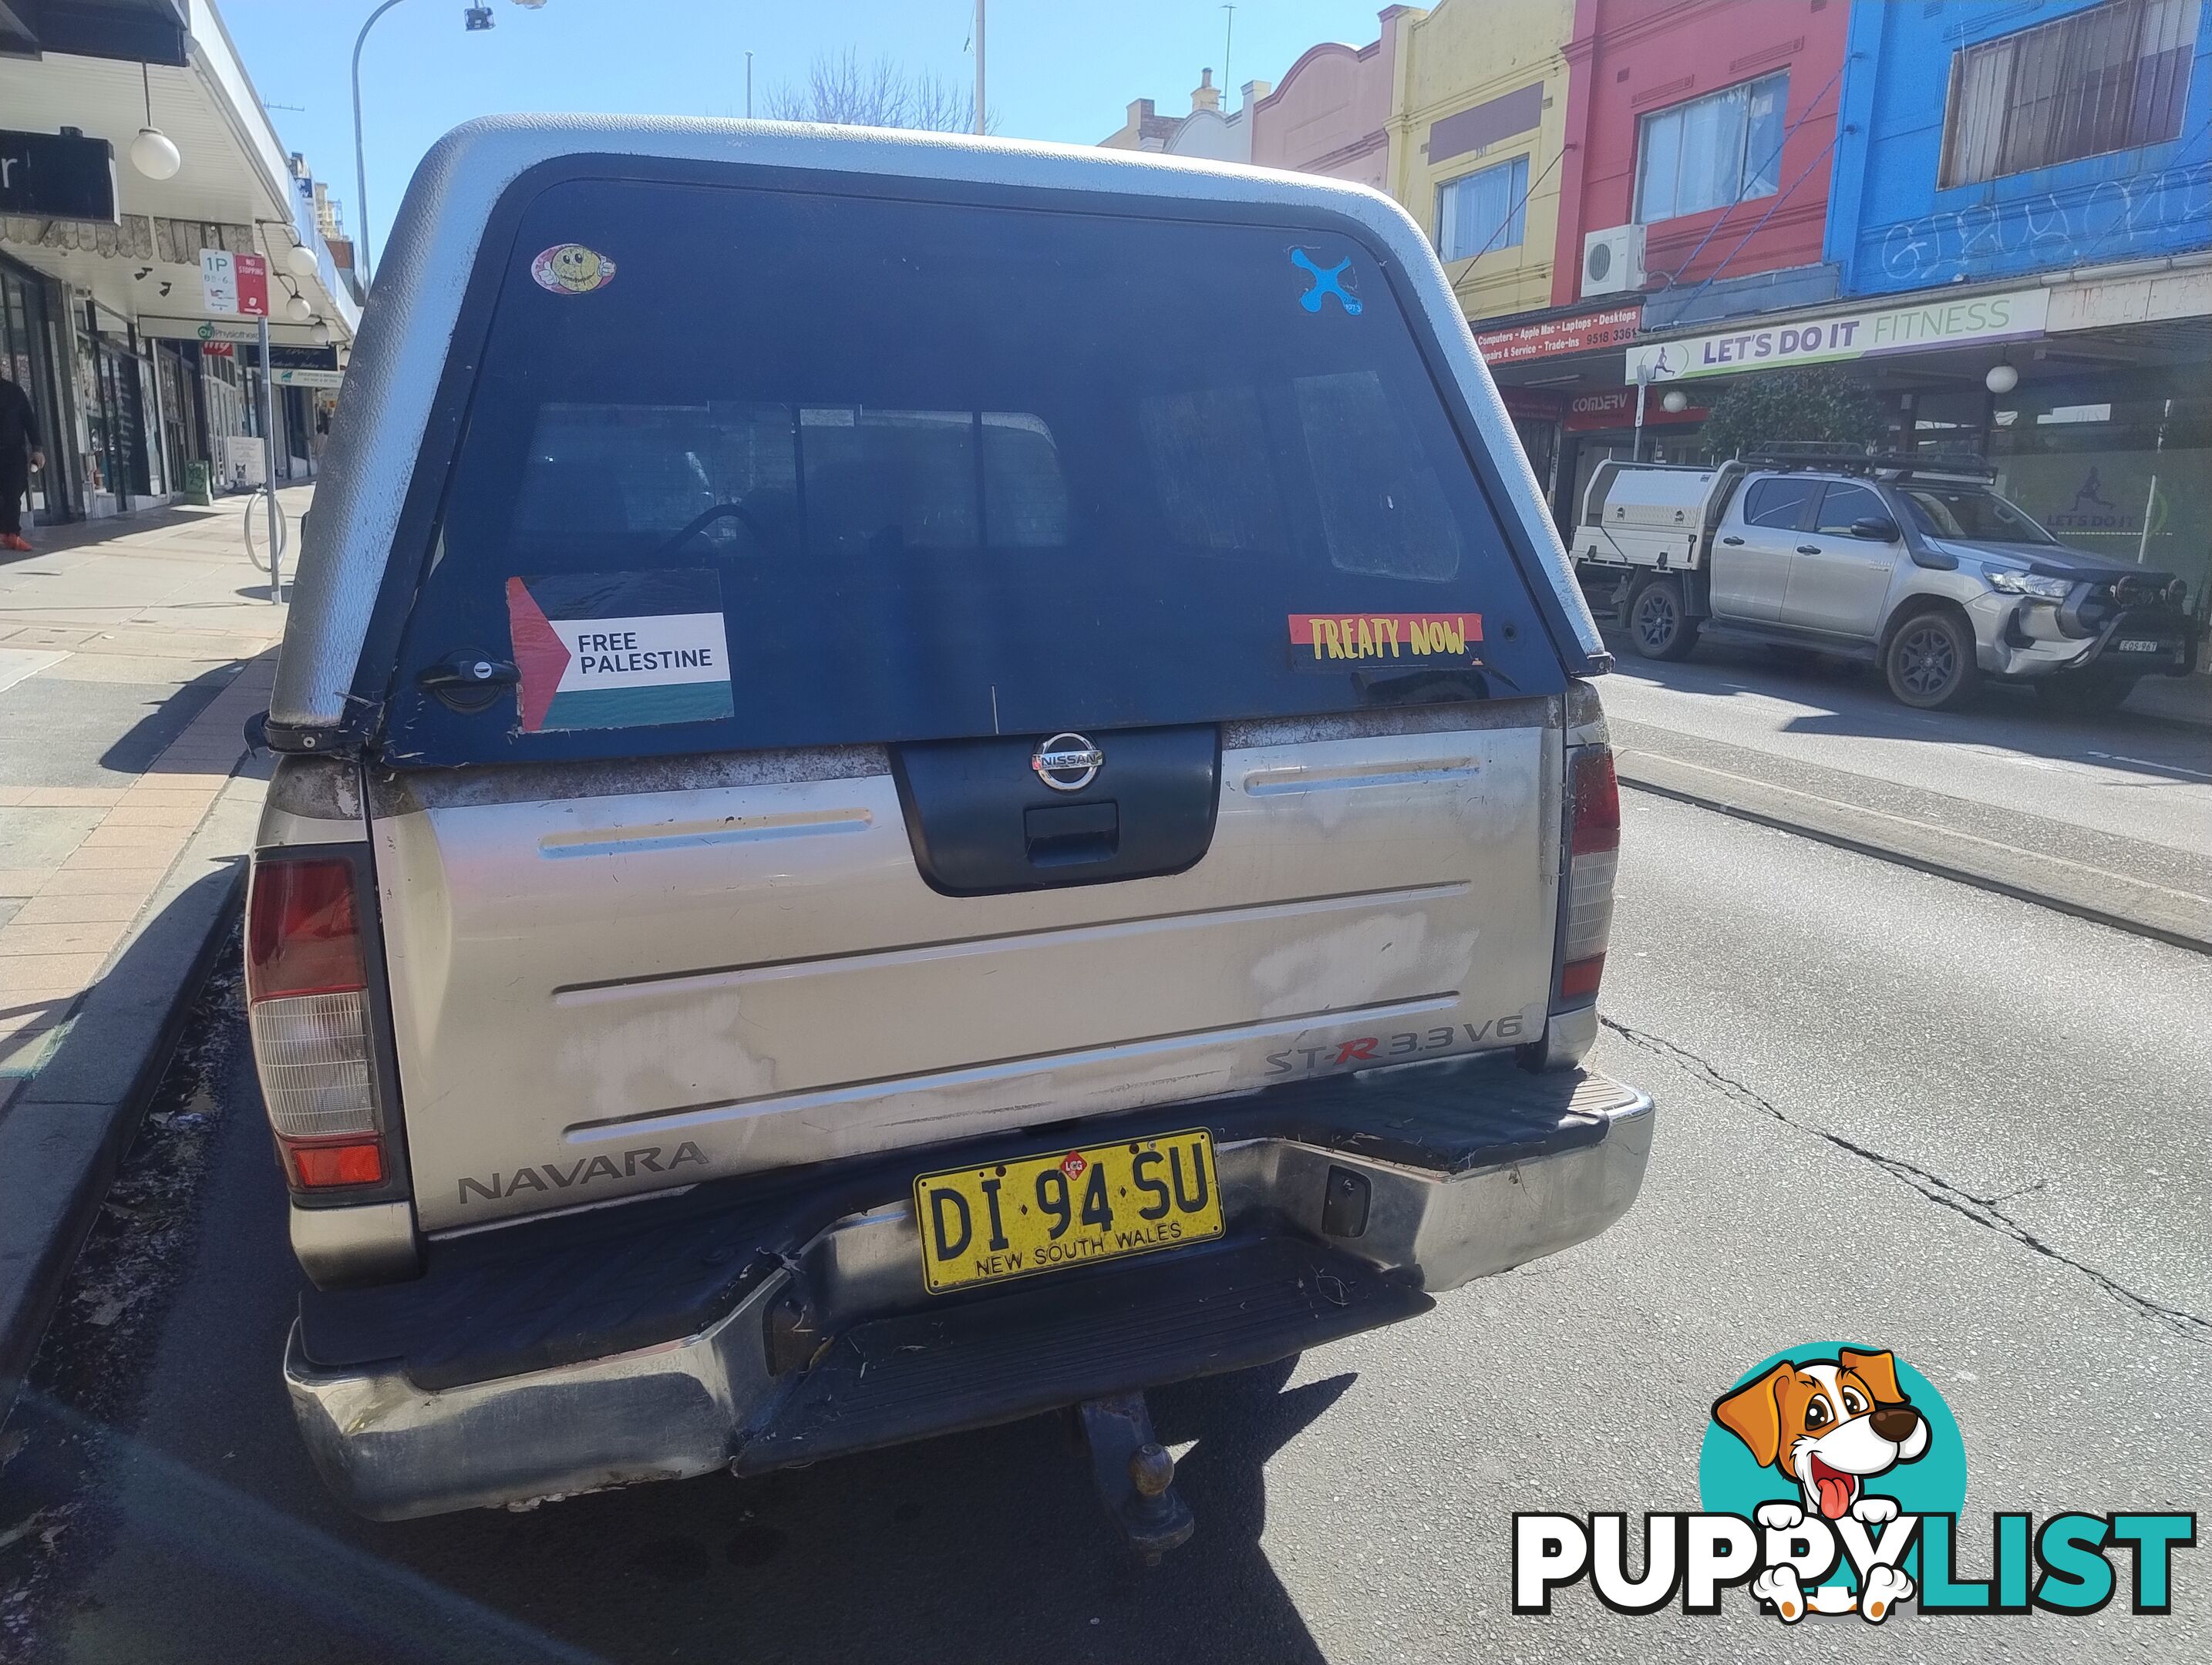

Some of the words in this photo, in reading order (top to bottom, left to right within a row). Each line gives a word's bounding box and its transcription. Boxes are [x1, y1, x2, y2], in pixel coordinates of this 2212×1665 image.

[207, 257, 228, 272] 1P
[238, 265, 264, 276] STOPPING
[1477, 332, 1513, 346] Computers
[1520, 327, 1539, 341] Apple
[1540, 324, 1555, 336] Mac
[1562, 318, 1591, 333] Laptops
[1599, 310, 1637, 325] Desktops
[1587, 332, 1609, 346] 9518
[1703, 334, 1773, 365] LET'S
[1779, 326, 1823, 355] DO
[1829, 321, 1860, 348] IT
[1874, 299, 2011, 344] FITNESS
[1504, 348, 1509, 358] &
[1510, 345, 1537, 357] Service
[1544, 338, 1580, 352] Trade-Ins
[2091, 515, 2116, 527] DO
[577, 632, 638, 653] FREE
[1308, 617, 1400, 661] TREATY
[1409, 617, 1466, 656] NOW
[580, 648, 713, 674] PALESTINE
[1042, 754, 1096, 766] NISSAN
[1389, 1027, 1454, 1055] 3.3
[1463, 1014, 1523, 1043] V6
[457, 1141, 710, 1205] NAVARA
[976, 1251, 1023, 1276] NEW
[1034, 1238, 1104, 1265] SOUTH
[1115, 1222, 1182, 1249] WALES
